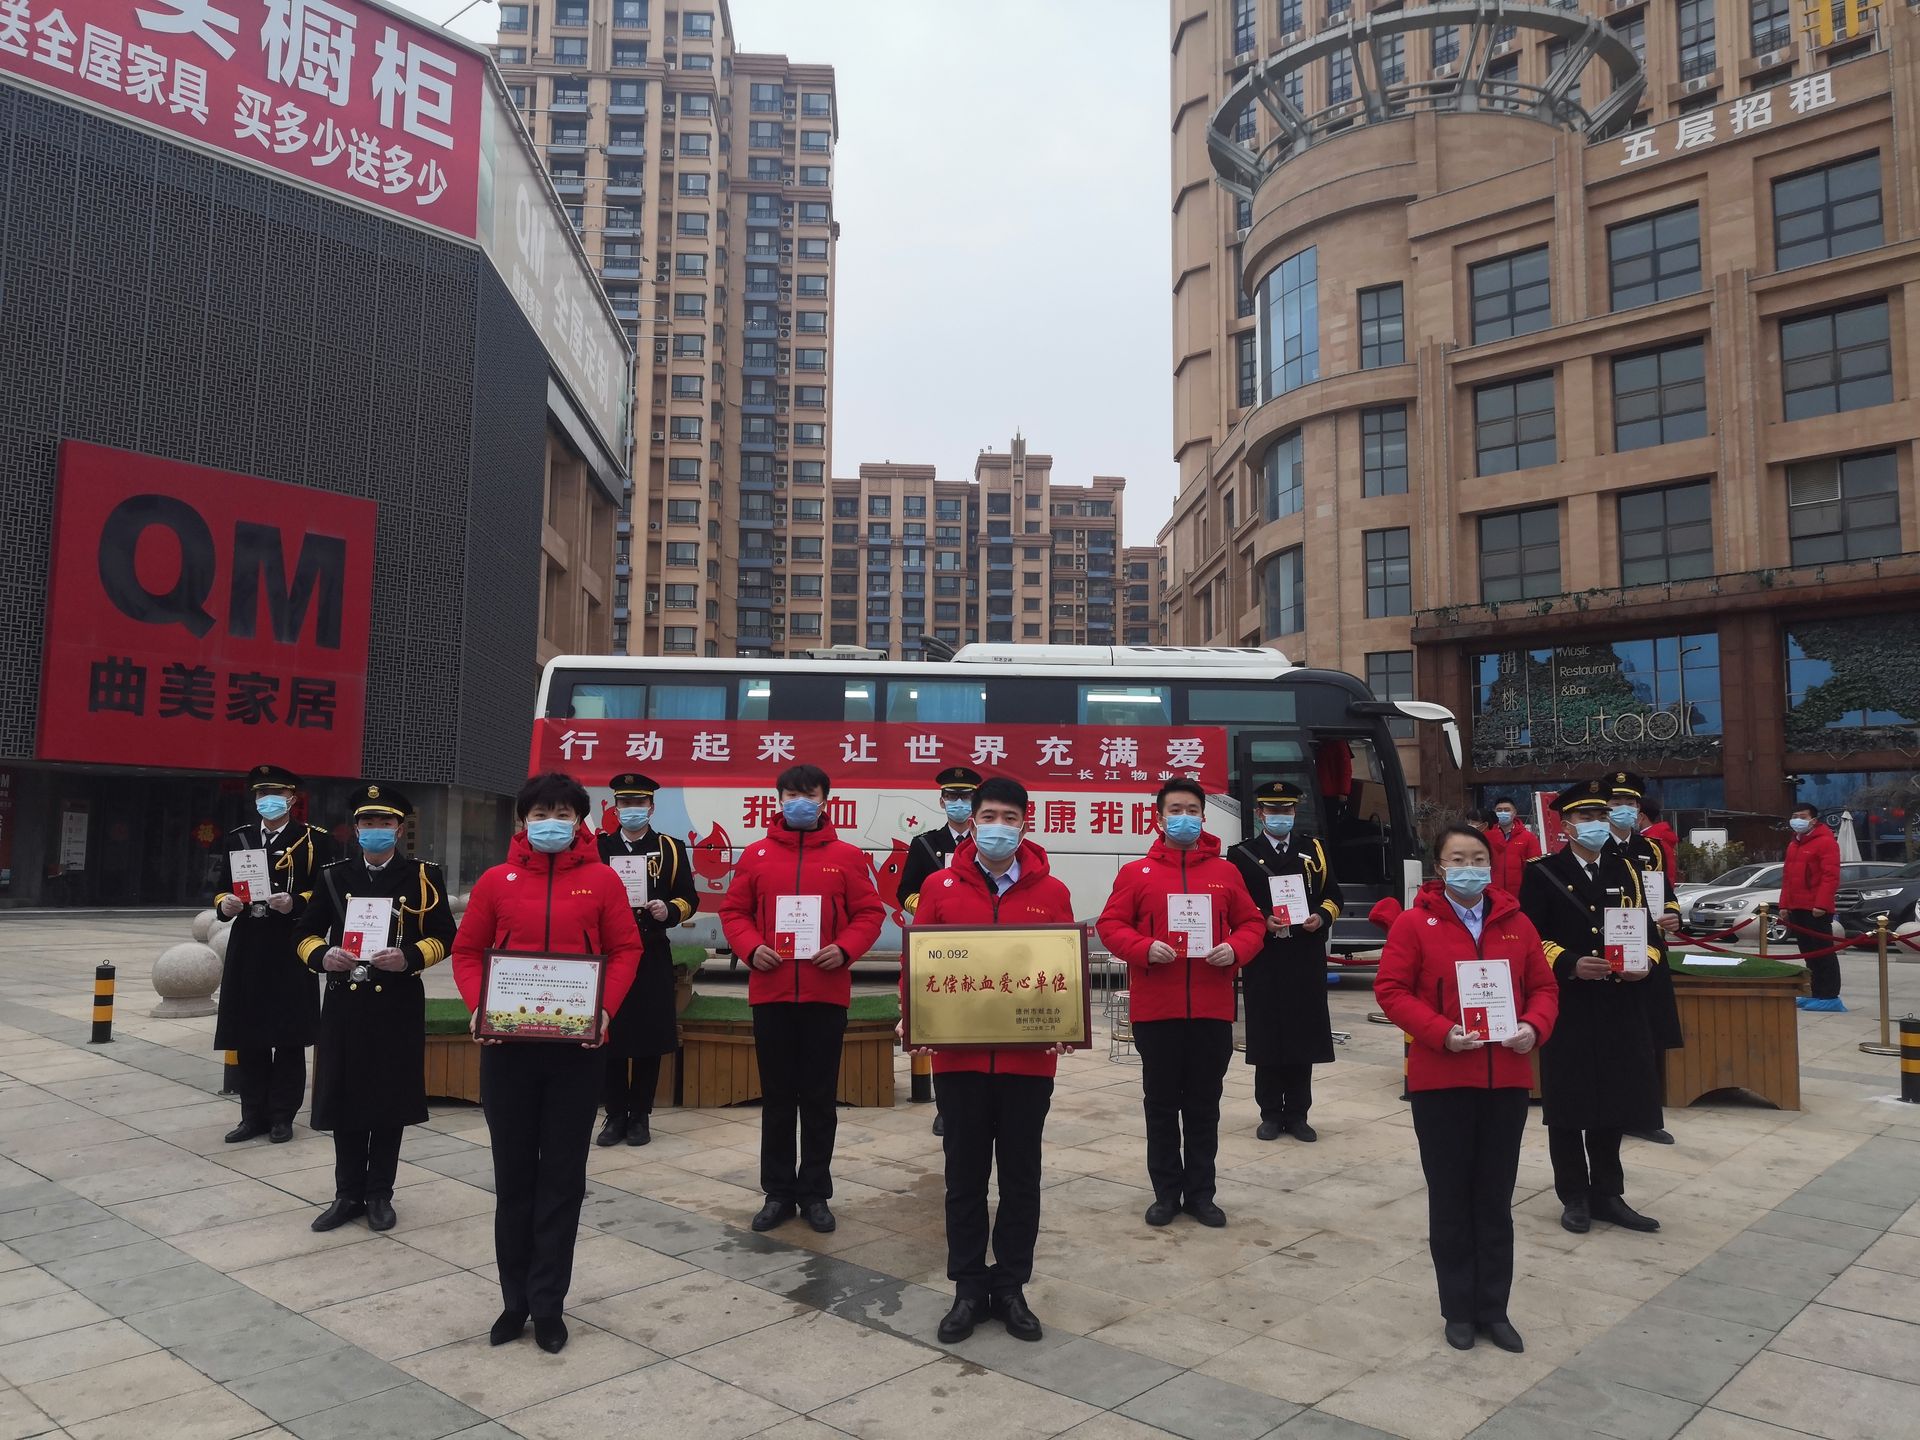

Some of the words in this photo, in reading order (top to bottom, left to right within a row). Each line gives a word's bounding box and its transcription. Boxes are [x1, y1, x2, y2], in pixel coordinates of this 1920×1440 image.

[234, 85, 449, 207] 买多少送多少
[1619, 71, 1837, 167] 五层招租
[515, 183, 546, 288] QM
[553, 273, 609, 413] 全屋定制
[97, 493, 348, 650] QM
[1558, 645, 1592, 658] Music
[1560, 661, 1617, 677] Restaurant
[88, 655, 338, 731] 曲美家居
[1501, 650, 1521, 749] 胡桃里
[1561, 684, 1589, 697] &Bar
[559, 729, 797, 763] 行动起来
[839, 732, 1207, 769] 让世界充满爱
[742, 795, 858, 829] 我血
[925, 970, 1068, 994] 无偿献血爱心单位
[928, 949, 969, 960] NO.092
